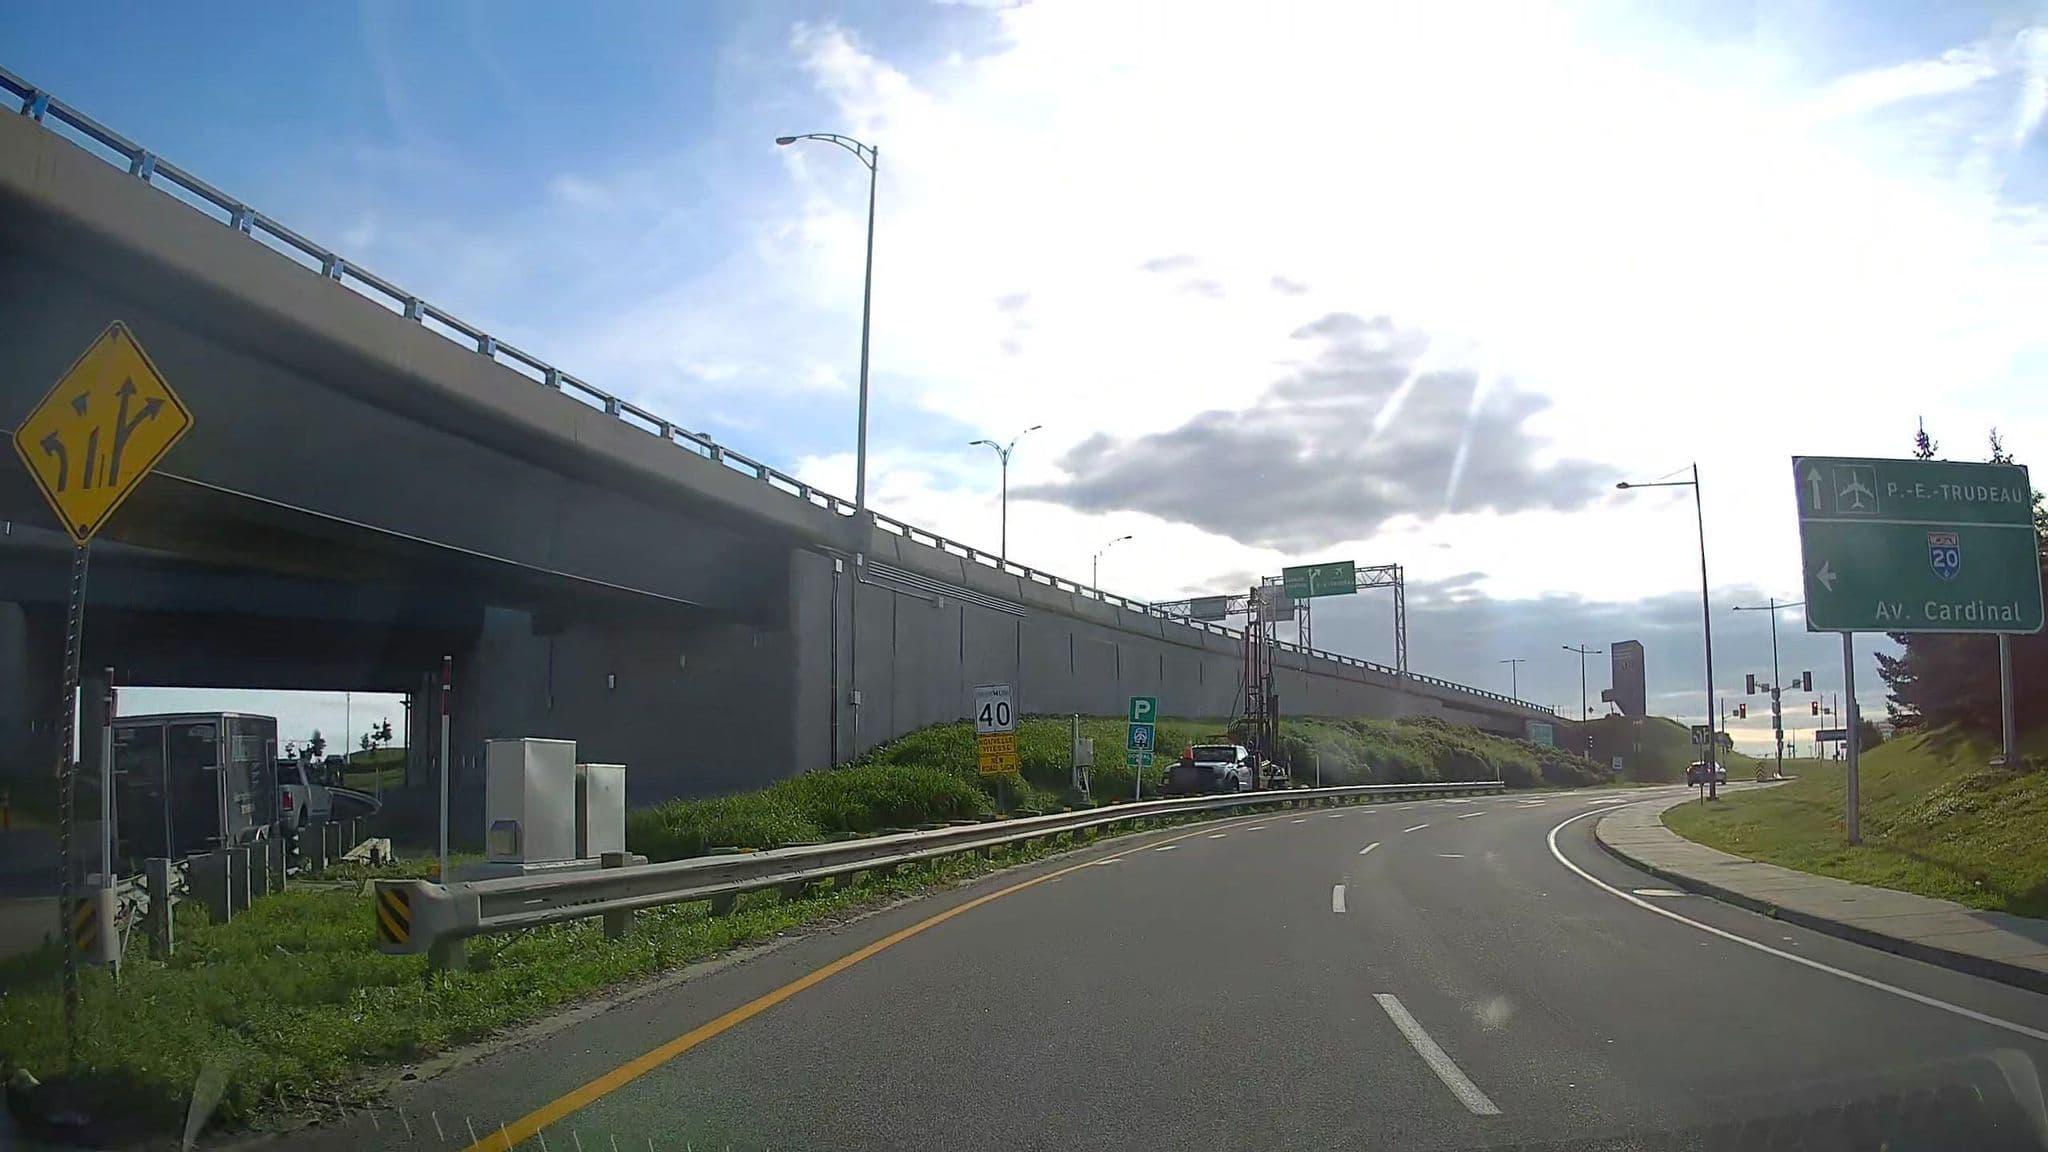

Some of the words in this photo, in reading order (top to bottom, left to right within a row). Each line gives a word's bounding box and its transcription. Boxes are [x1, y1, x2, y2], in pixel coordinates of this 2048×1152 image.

[1887, 482, 2023, 504] P.-E.-TRUDEAU
[1932, 549, 1959, 568] 20
[1875, 600, 1911, 621] Av.
[1924, 600, 2022, 622] Cardinal
[979, 701, 1011, 727] 40
[1134, 699, 1151, 720] P
